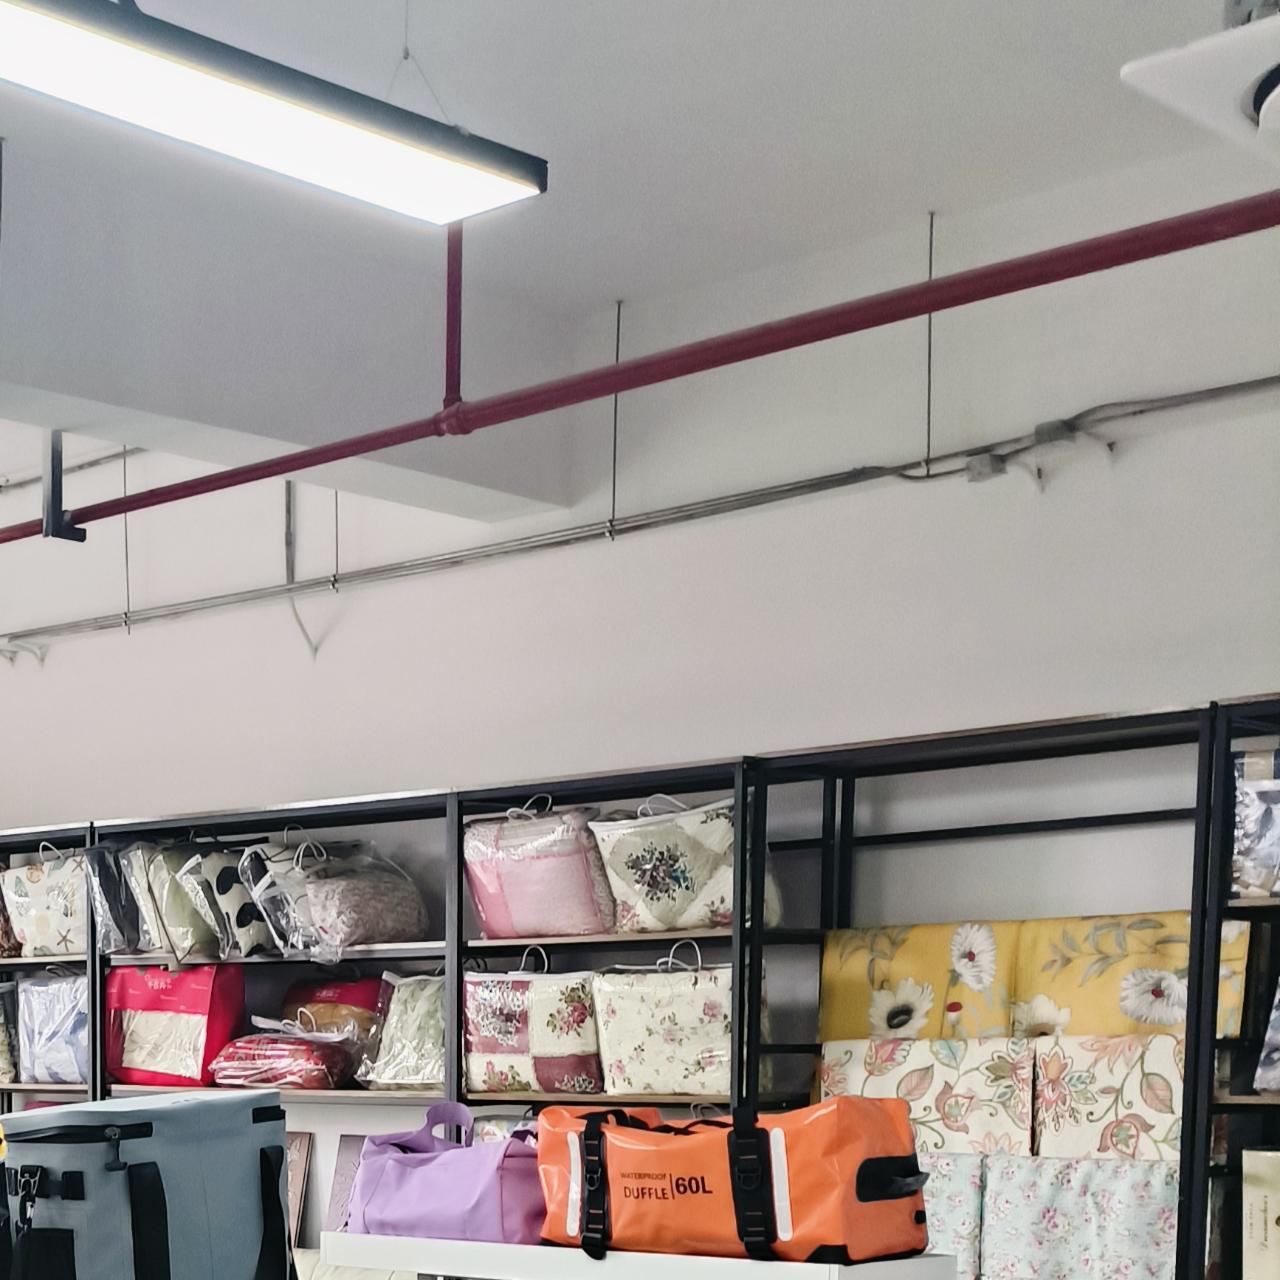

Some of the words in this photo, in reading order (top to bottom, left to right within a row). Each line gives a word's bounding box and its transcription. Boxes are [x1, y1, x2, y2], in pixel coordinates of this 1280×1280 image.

[621, 1172, 667, 1180] WATERPROOF
[675, 1176, 713, 1194] 60L
[624, 1186, 669, 1199] DUFFLE
